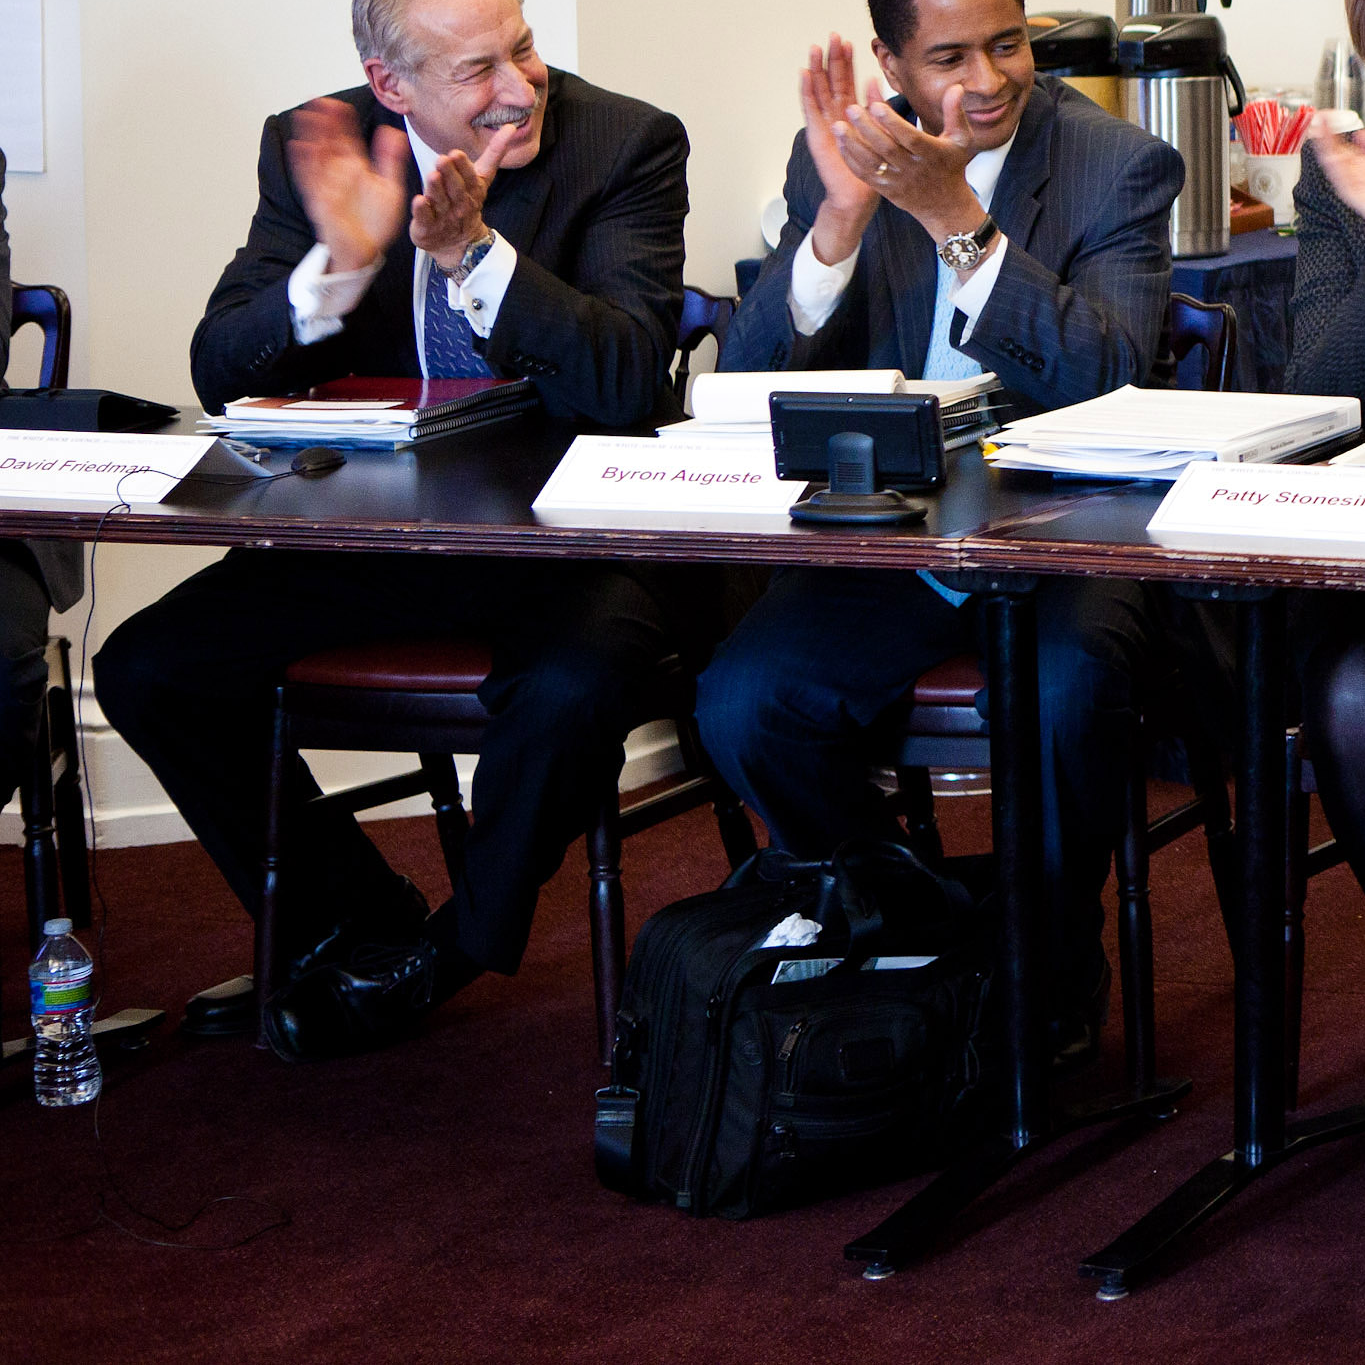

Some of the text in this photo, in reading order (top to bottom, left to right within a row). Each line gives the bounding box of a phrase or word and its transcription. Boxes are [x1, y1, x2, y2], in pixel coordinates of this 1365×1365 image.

[0, 457, 151, 475] David Friedman
[601, 466, 762, 486] Byron Auguste
[1210, 488, 1270, 505] Patty
